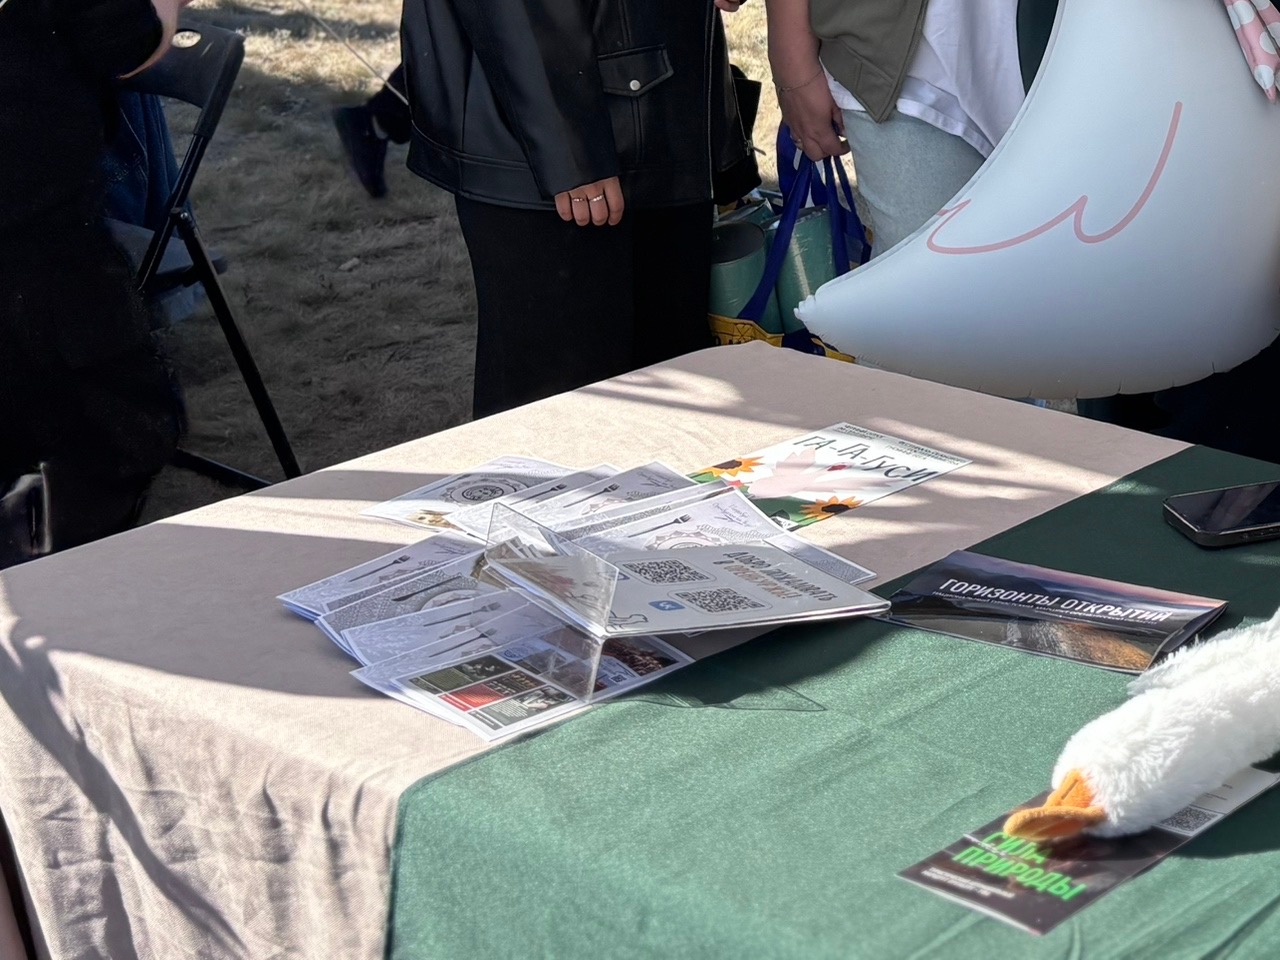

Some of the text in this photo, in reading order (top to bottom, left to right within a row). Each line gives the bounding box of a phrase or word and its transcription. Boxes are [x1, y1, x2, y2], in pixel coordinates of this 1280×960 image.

[793, 436, 939, 482] ГА-ГА-ГУСИ
[939, 578, 1173, 622] ГОРИЗОНТЫ ОТКРЫТИЙ
[952, 846, 1089, 902] ПРИРОДЫ
